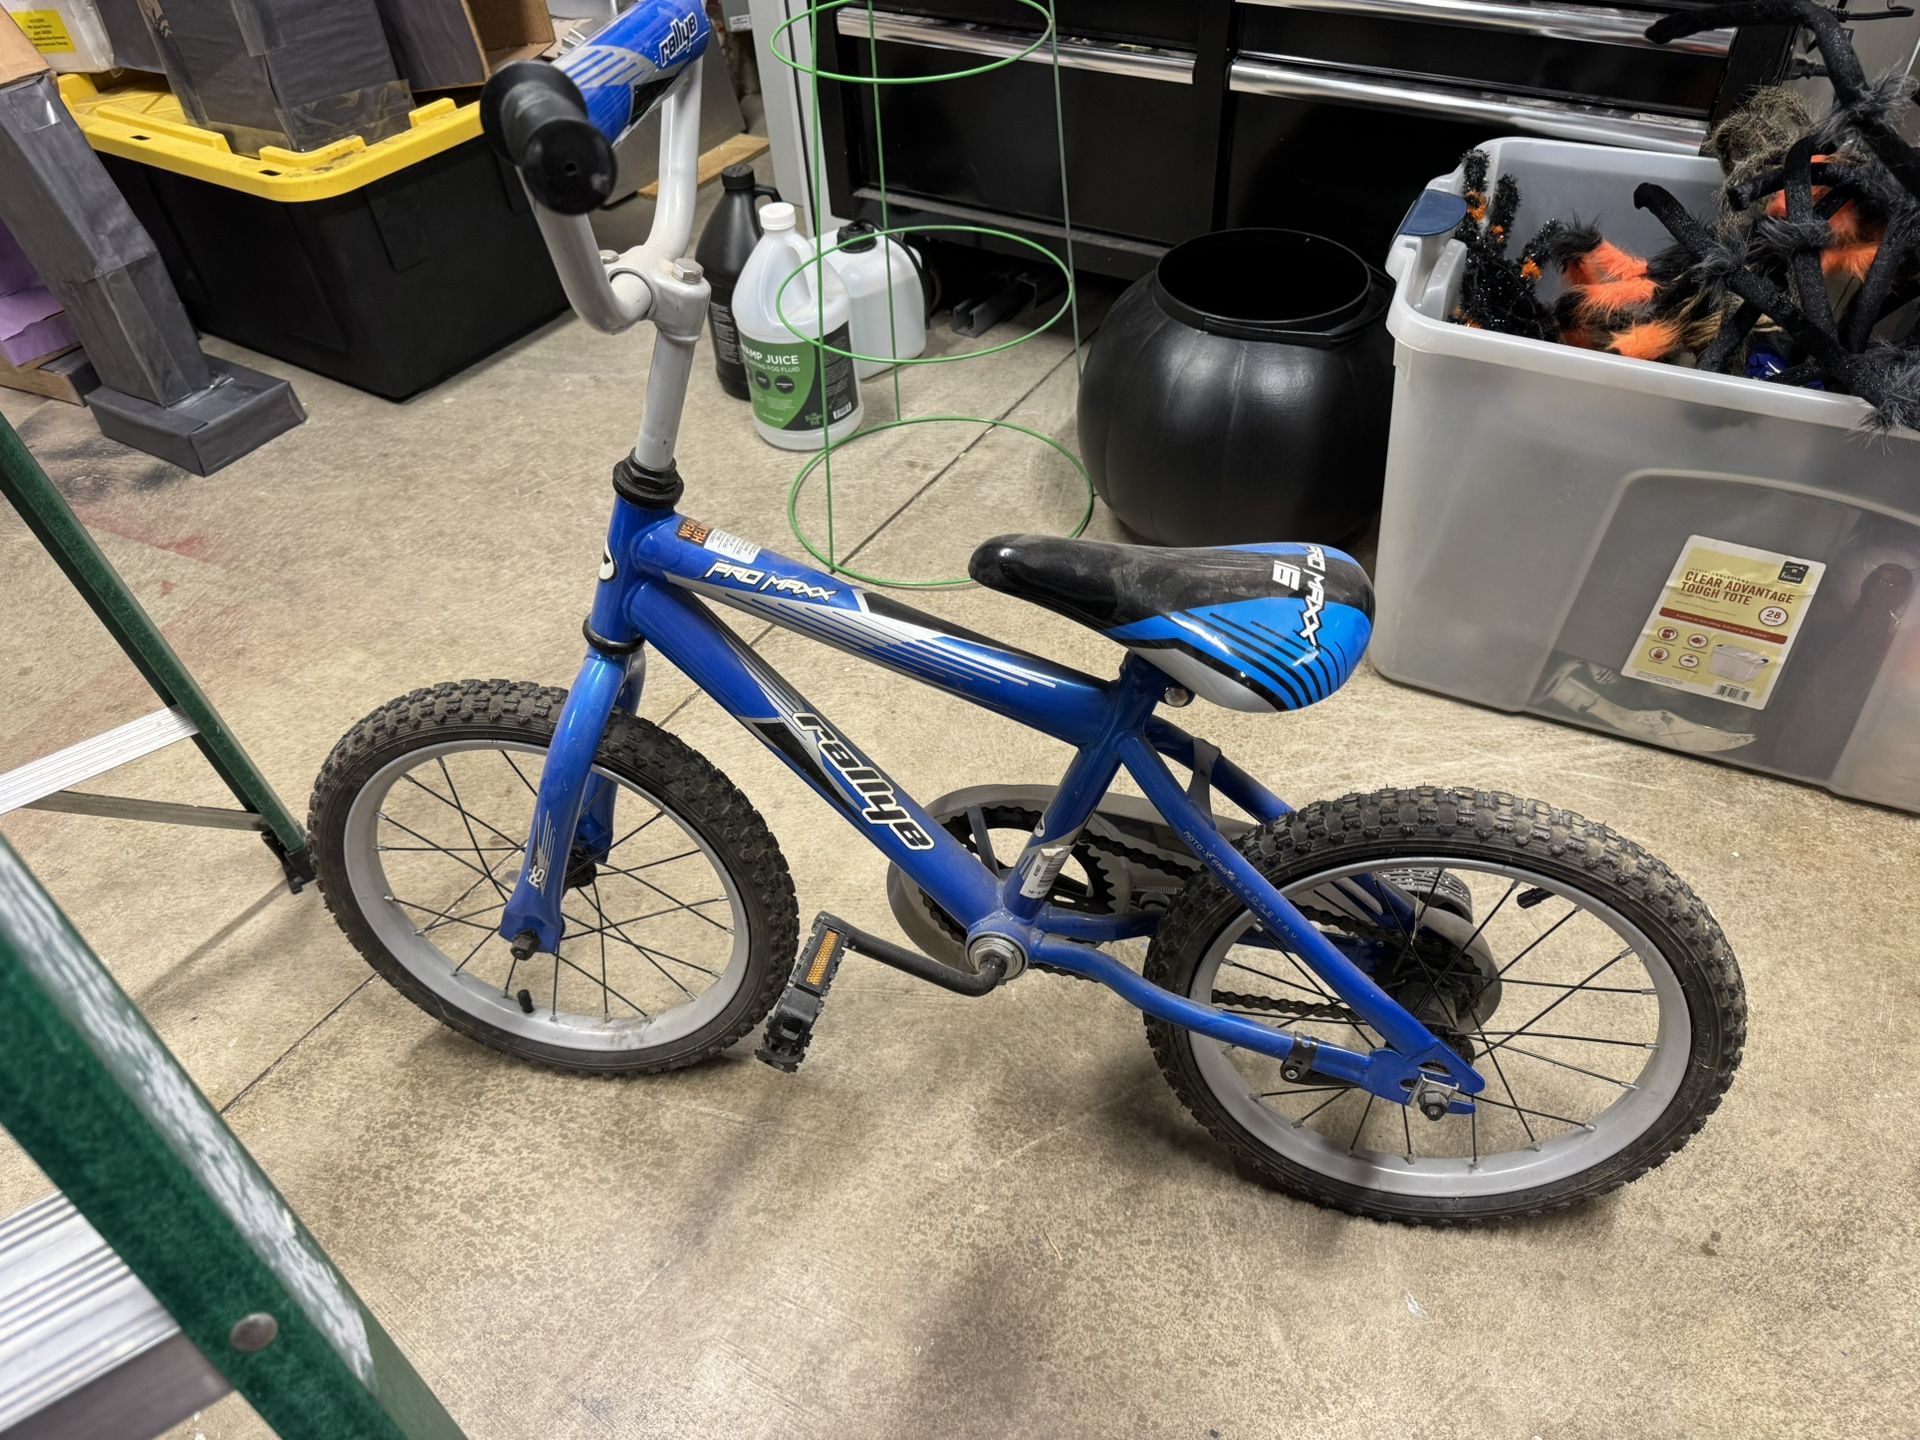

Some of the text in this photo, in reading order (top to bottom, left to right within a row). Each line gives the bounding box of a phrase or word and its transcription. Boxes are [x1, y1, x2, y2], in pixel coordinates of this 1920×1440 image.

[659, 12, 698, 67] rallye
[765, 354, 800, 365] JUICE
[704, 562, 837, 601] PRO MAXX
[1681, 581, 1720, 599] TOUGH
[1723, 591, 1752, 606] TOTE
[1685, 571, 1722, 588] CLEAR
[1725, 581, 1795, 604] ADVANTAGE
[1766, 610, 1782, 620] 28
[792, 712, 935, 850] rallye
